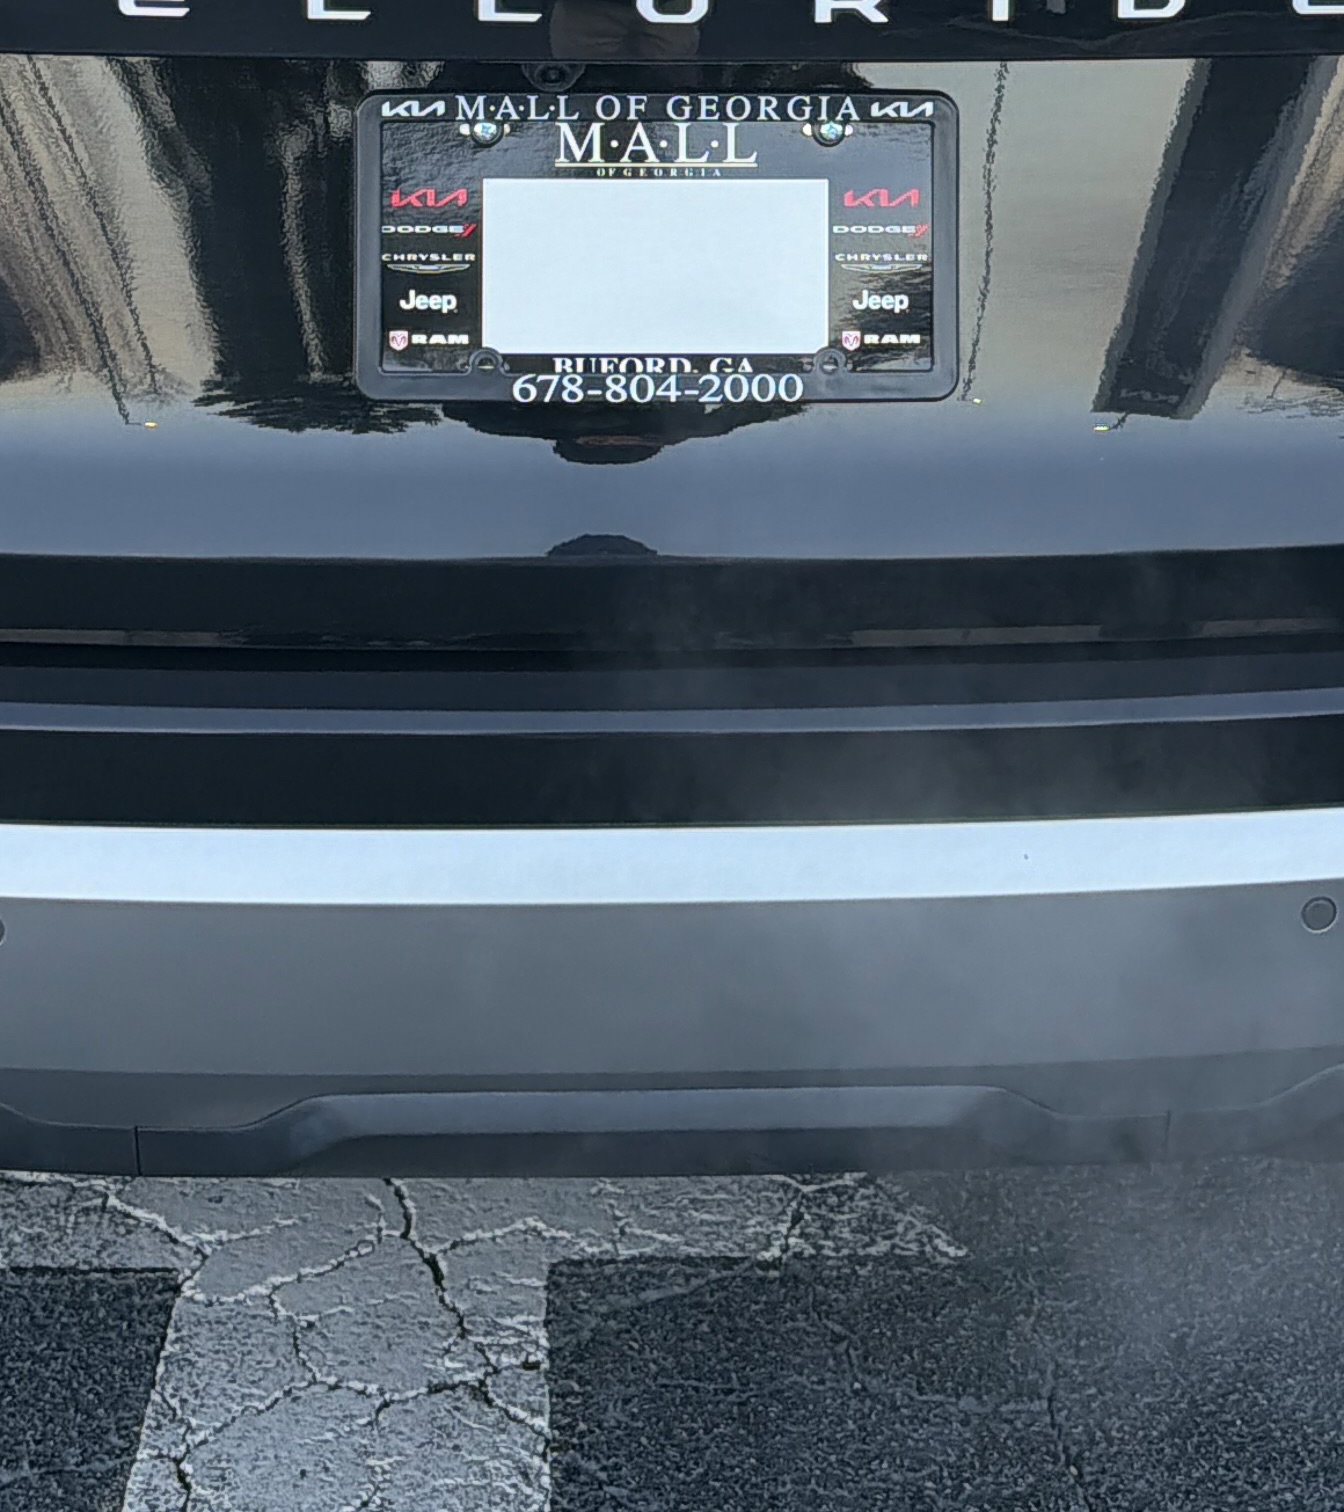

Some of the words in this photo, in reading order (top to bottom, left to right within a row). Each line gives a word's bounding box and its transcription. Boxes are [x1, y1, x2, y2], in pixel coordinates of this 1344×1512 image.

[381, 100, 446, 117] KIA
[595, 95, 648, 120] OF
[666, 95, 861, 121] GEORGIA
[870, 101, 935, 118] KIA
[596, 167, 616, 177] OF
[623, 167, 722, 177] GEORGIA
[391, 187, 468, 207] KIA
[843, 188, 920, 207] KIA
[381, 225, 465, 234] DODGE
[832, 225, 917, 234] DODGE
[381, 253, 476, 262] CHRYSLER
[835, 253, 929, 262] CHRYSLER
[399, 289, 458, 314] Jeep
[852, 290, 909, 314] Jeep
[412, 333, 470, 345] RAM
[864, 333, 921, 345] RAM
[709, 357, 754, 374] GA
[512, 373, 804, 404] 678-804-2000
